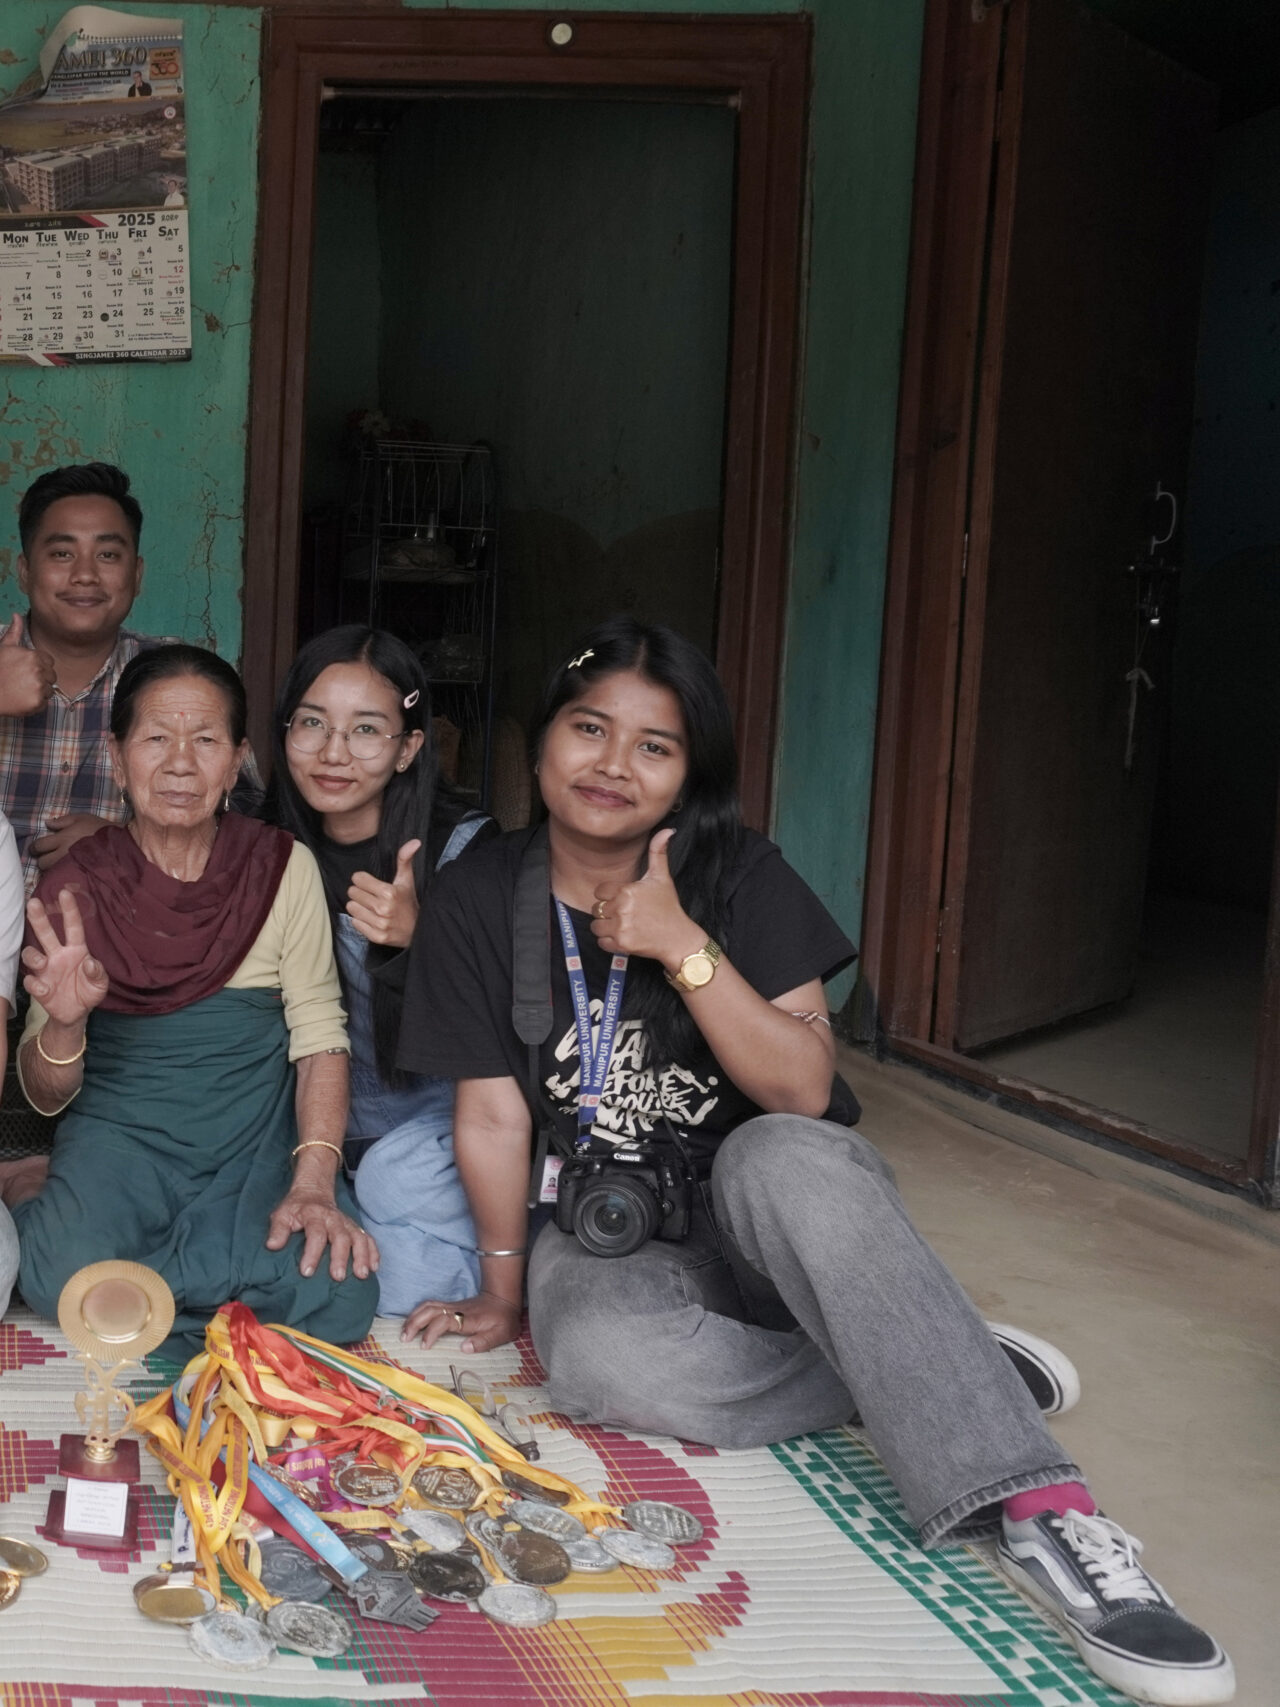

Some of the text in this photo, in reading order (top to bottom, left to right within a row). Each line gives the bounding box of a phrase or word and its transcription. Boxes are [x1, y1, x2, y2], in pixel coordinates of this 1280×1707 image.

[118, 213, 156, 227] 2025
[86, 249, 91, 257] 2
[117, 248, 122, 256] 3
[147, 246, 152, 254] 4
[178, 245, 183, 253] 5
[56, 271, 61, 279] 8
[113, 268, 122, 276] 10
[174, 265, 184, 273] 12
[22, 293, 32, 301] 14
[52, 292, 62, 300] 15
[82, 290, 93, 298] 16
[112, 289, 123, 297] 17
[144, 288, 153, 296] 18
[174, 286, 185, 294] 19
[23, 313, 33, 321] 21
[52, 312, 63, 320] 22
[82, 311, 93, 319] 23
[113, 309, 123, 317] 24
[143, 308, 154, 316] 25
[22, 333, 33, 341] 28
[52, 332, 63, 340] 29
[83, 331, 94, 339] 30
[115, 330, 125, 338] 31
[130, 350, 167, 358] CALENDAR
[574, 980, 591, 1086] MANIPUR UNIVERSITY
[593, 979, 621, 1088] MANIPUR UNIVERSITY
[613, 1152, 641, 1162] Canon
